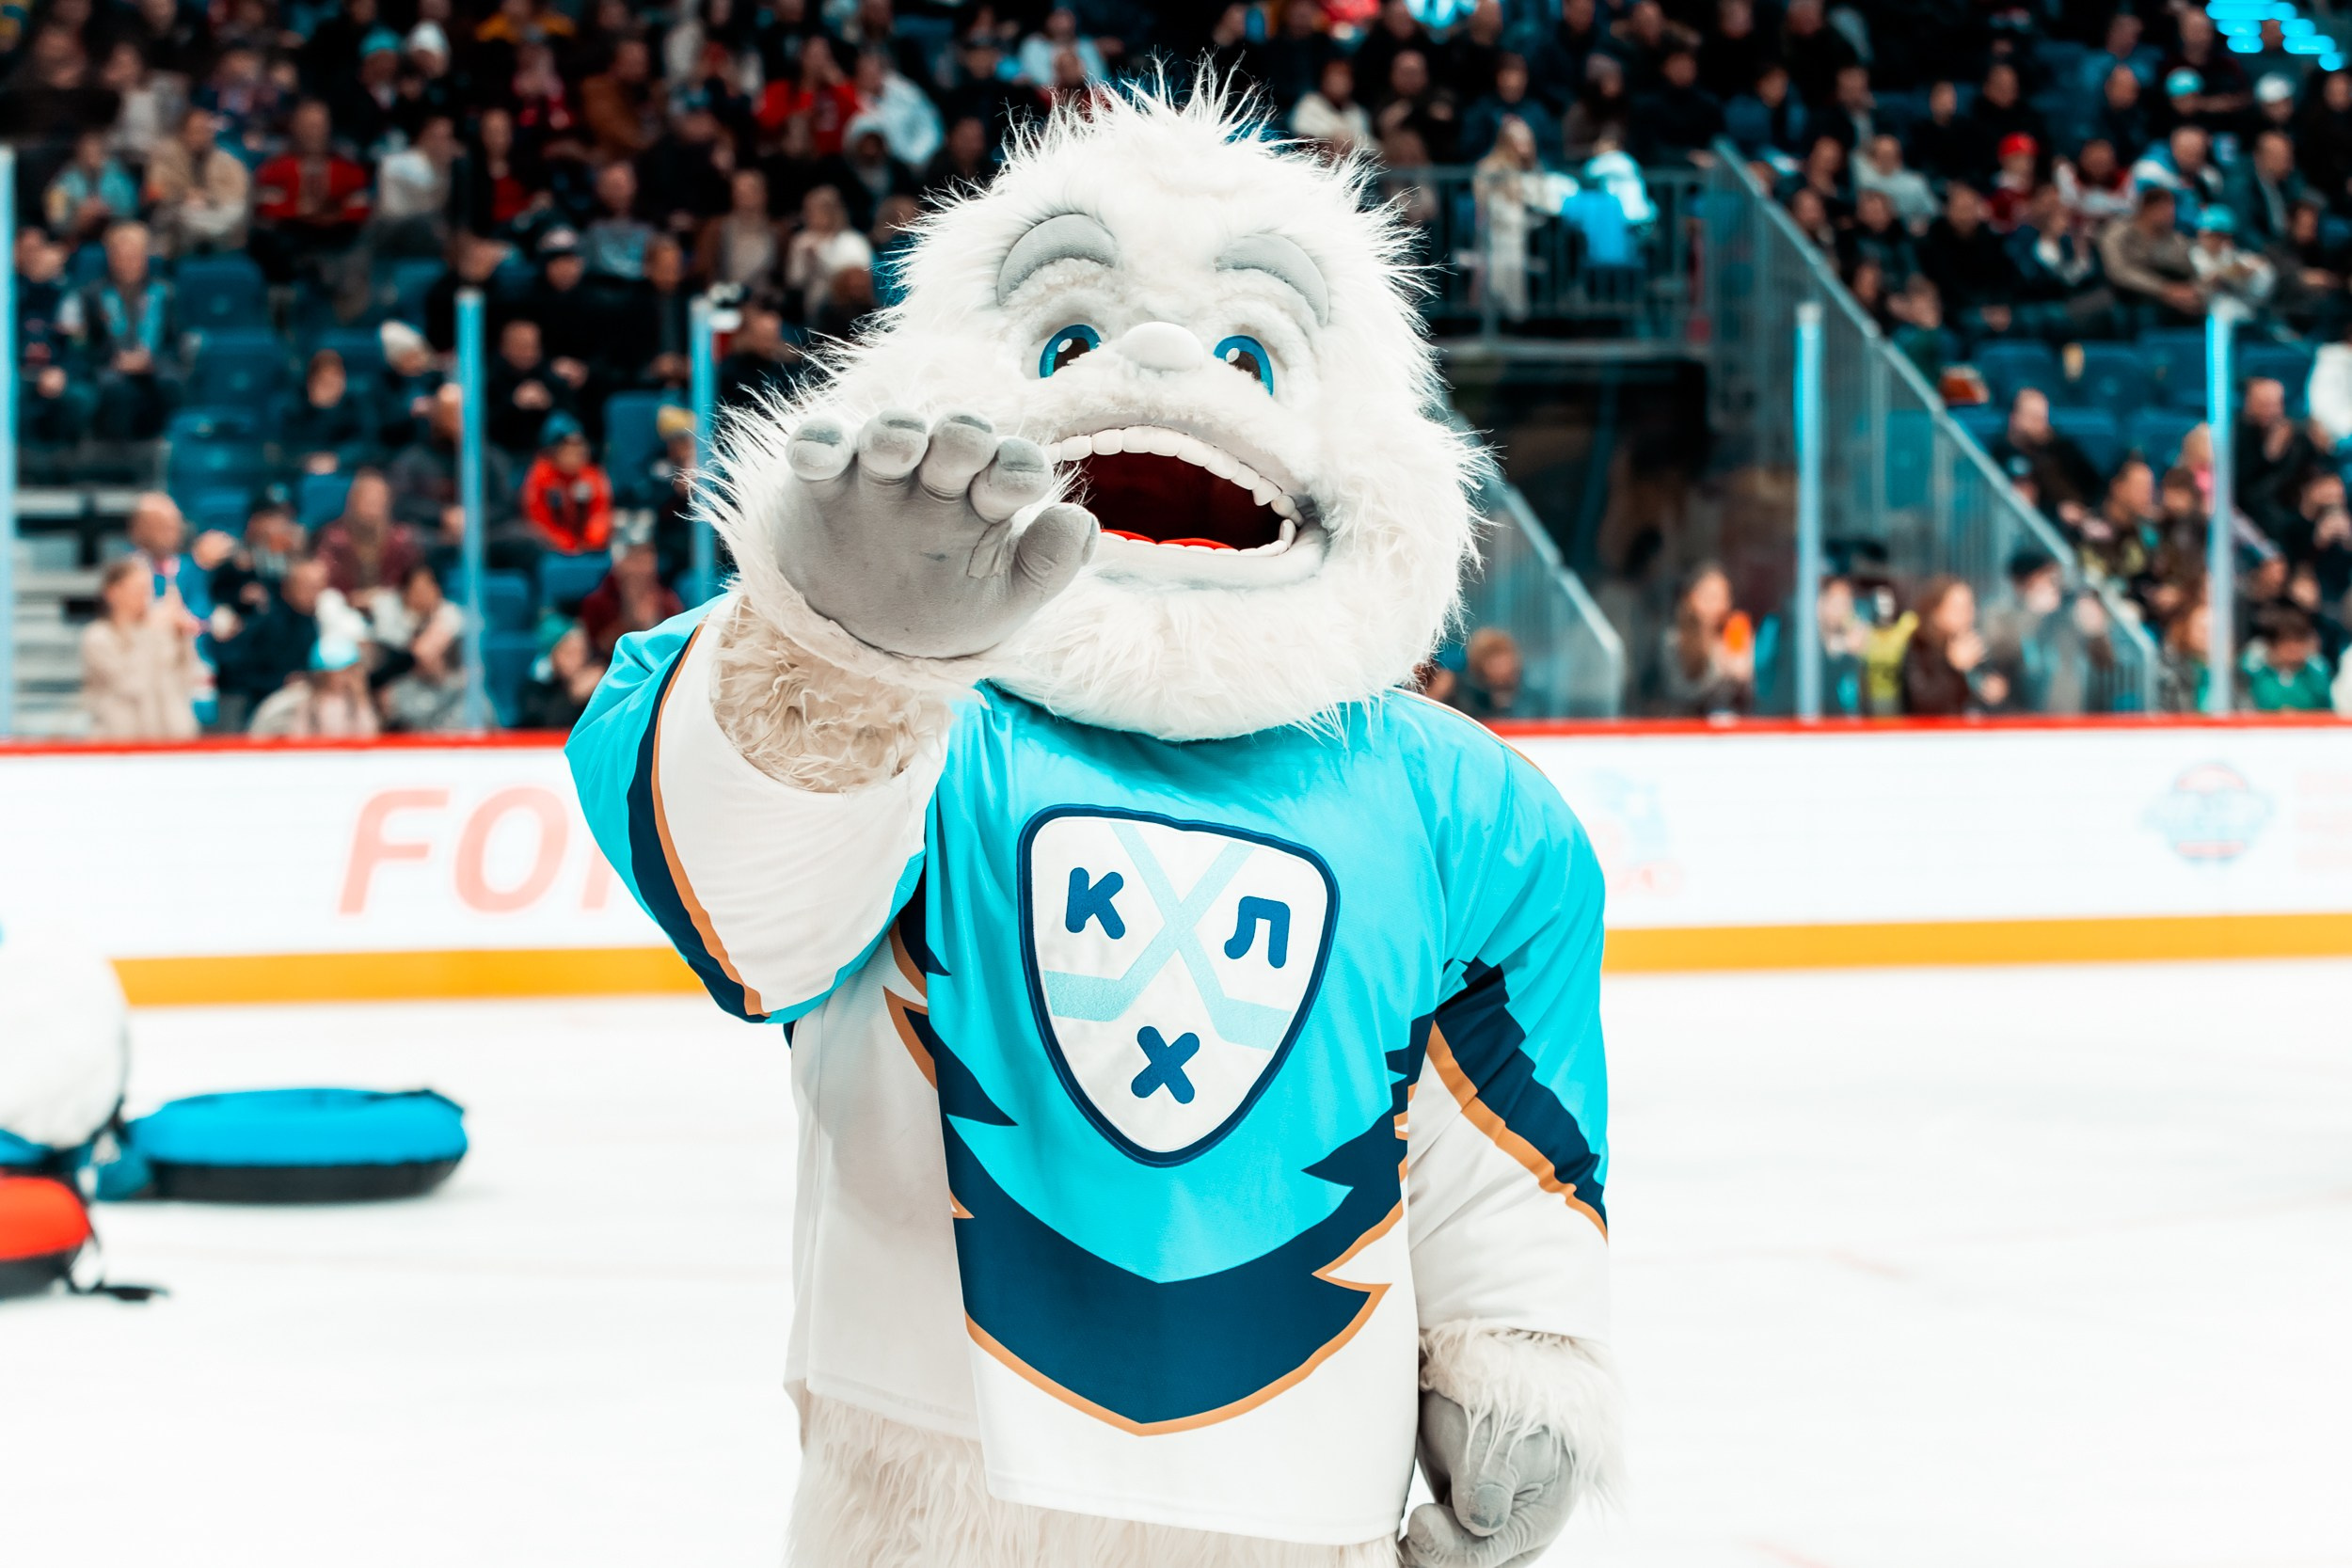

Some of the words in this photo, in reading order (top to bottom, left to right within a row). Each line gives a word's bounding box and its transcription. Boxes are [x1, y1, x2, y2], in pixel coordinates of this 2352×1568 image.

[1065, 866, 1126, 940] К
[1223, 895, 1291, 969] Л
[1131, 1025, 1200, 1104] Х
